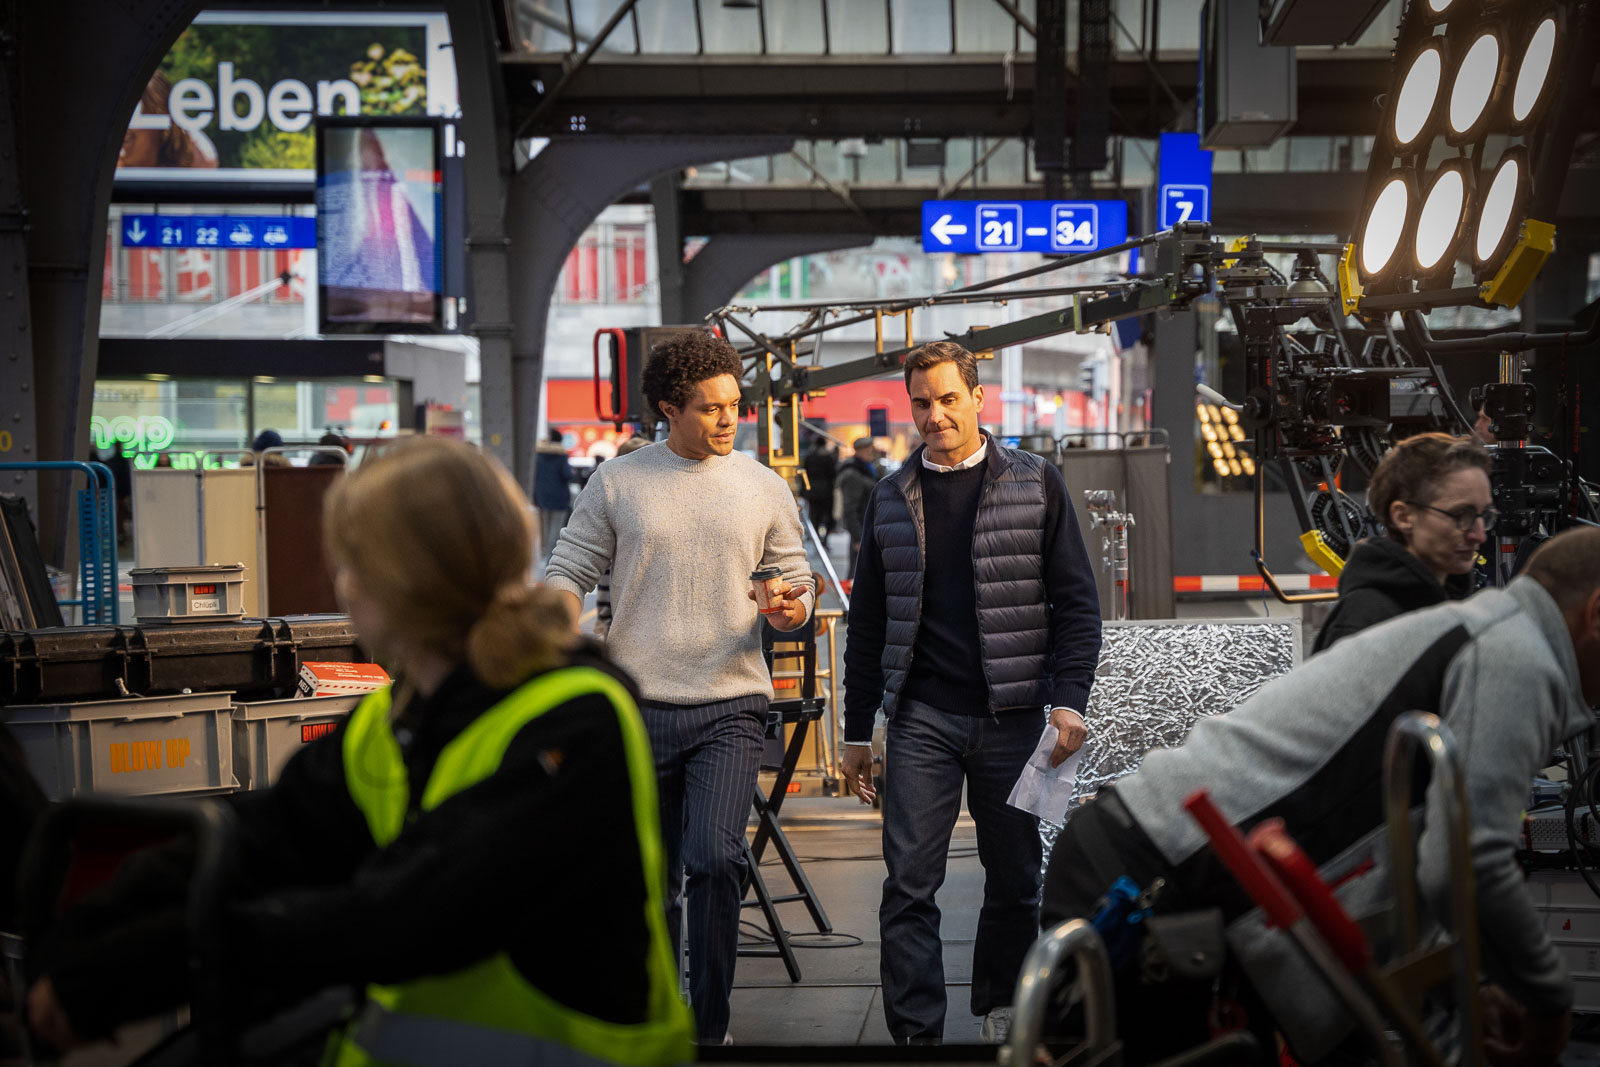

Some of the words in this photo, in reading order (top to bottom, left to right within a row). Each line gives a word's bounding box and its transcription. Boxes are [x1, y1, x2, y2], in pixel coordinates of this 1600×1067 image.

[1176, 201, 1194, 225] 7
[984, 220, 1013, 245] 21
[1056, 220, 1093, 245] 34
[303, 723, 327, 741] BLOW
[109, 740, 162, 773] BLOW
